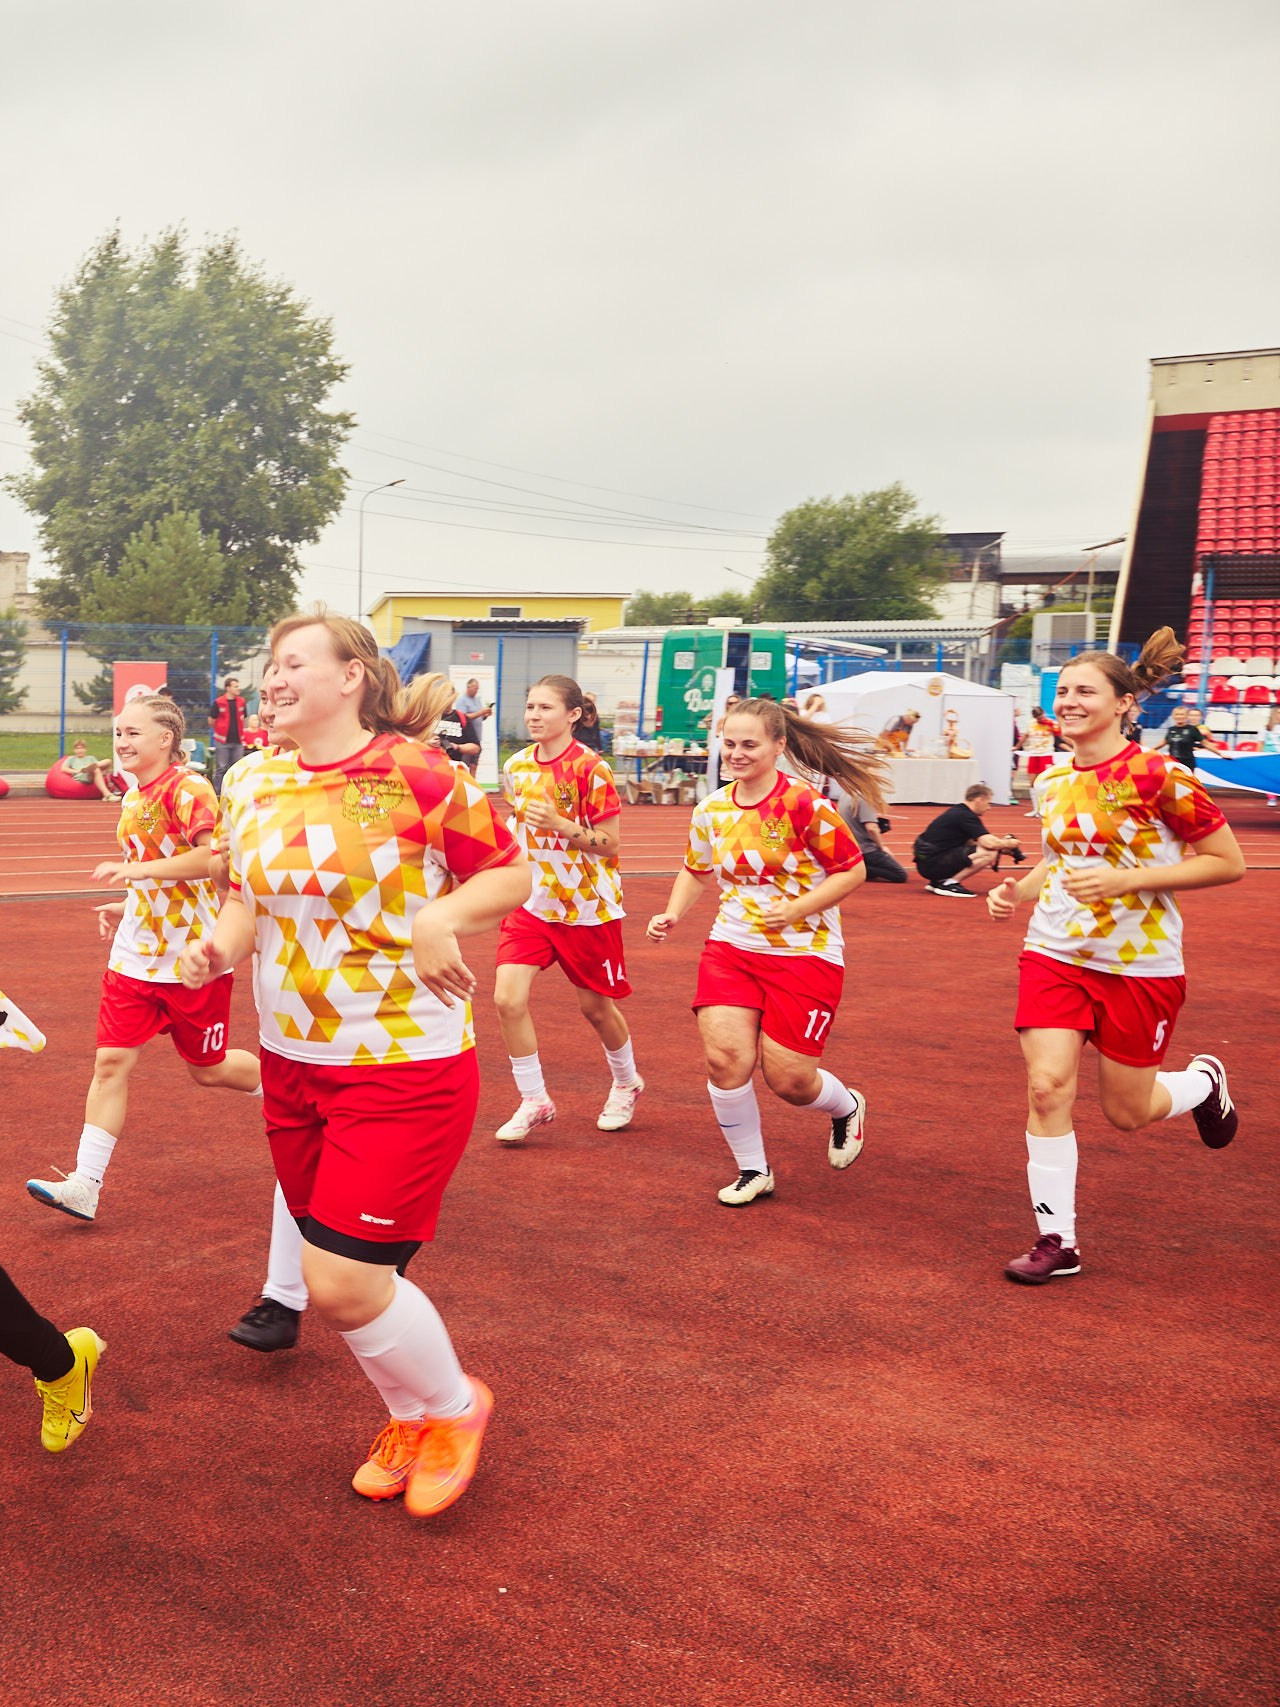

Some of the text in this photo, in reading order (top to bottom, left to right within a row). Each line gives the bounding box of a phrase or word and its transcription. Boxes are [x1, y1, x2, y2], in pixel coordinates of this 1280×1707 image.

[202, 1022, 225, 1054] 10
[804, 1008, 831, 1041] 17
[1152, 1019, 1168, 1052] 5
